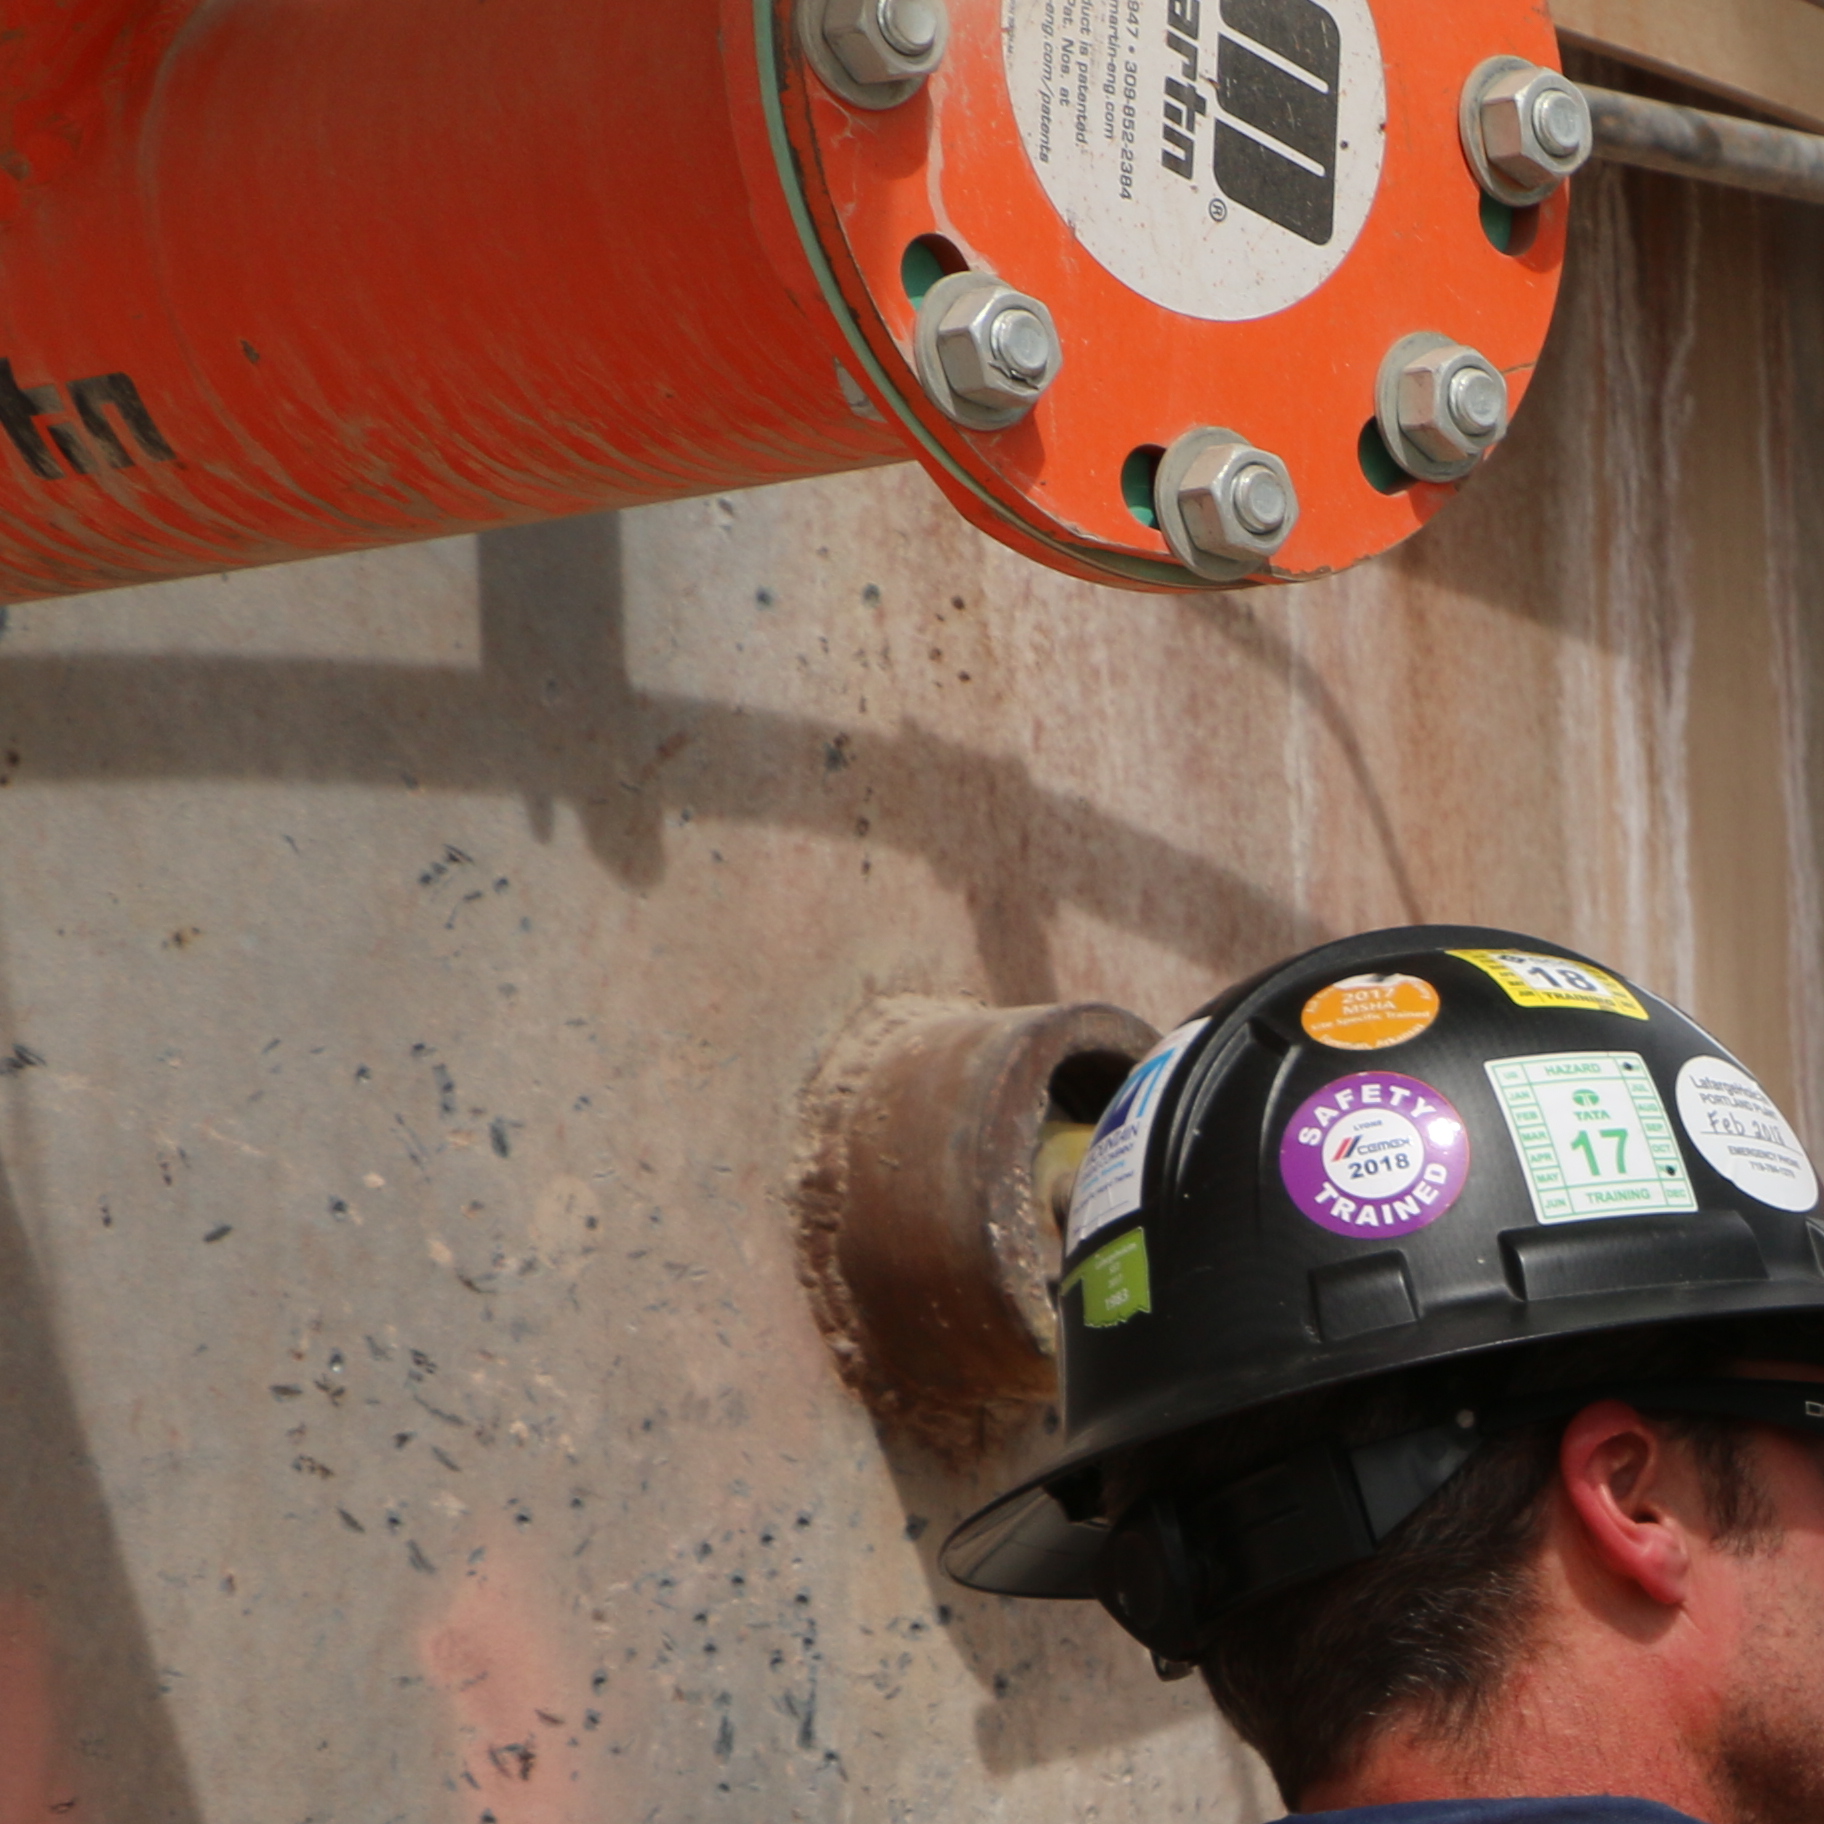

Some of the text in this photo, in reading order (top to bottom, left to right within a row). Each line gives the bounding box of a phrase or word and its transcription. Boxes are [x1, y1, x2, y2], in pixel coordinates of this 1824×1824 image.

[1060, 36, 1076, 80] Nos.
[1078, 40, 1091, 58] is
[1058, 87, 1071, 108] at
[1073, 60, 1090, 149] patented.
[1118, 59, 1138, 201] 309-852-2384
[1527, 965, 1598, 992] 18
[1342, 987, 1396, 1005] 2017
[1542, 990, 1617, 1006] TRAINING
[1342, 1000, 1397, 1015] MSHA
[1385, 1009, 1430, 1020] Trained
[1544, 1062, 1601, 1076] HAZARD
[1509, 1089, 1531, 1100] JAN
[1298, 1083, 1438, 1146] SAFETY
[1515, 1110, 1539, 1122] FEB
[1573, 1109, 1612, 1122] TATA
[1637, 1102, 1659, 1112] AUG
[1706, 1109, 1746, 1137] Feb
[1522, 1130, 1548, 1142] MAR
[1530, 1151, 1554, 1163] APR
[1570, 1128, 1630, 1177] 17
[1651, 1143, 1673, 1154] OCT
[1348, 1152, 1412, 1180] 2018
[1536, 1172, 1559, 1183] MAY
[1314, 1162, 1449, 1228] TRAINED
[1544, 1187, 1687, 1210] JUN TRAINING DEC
